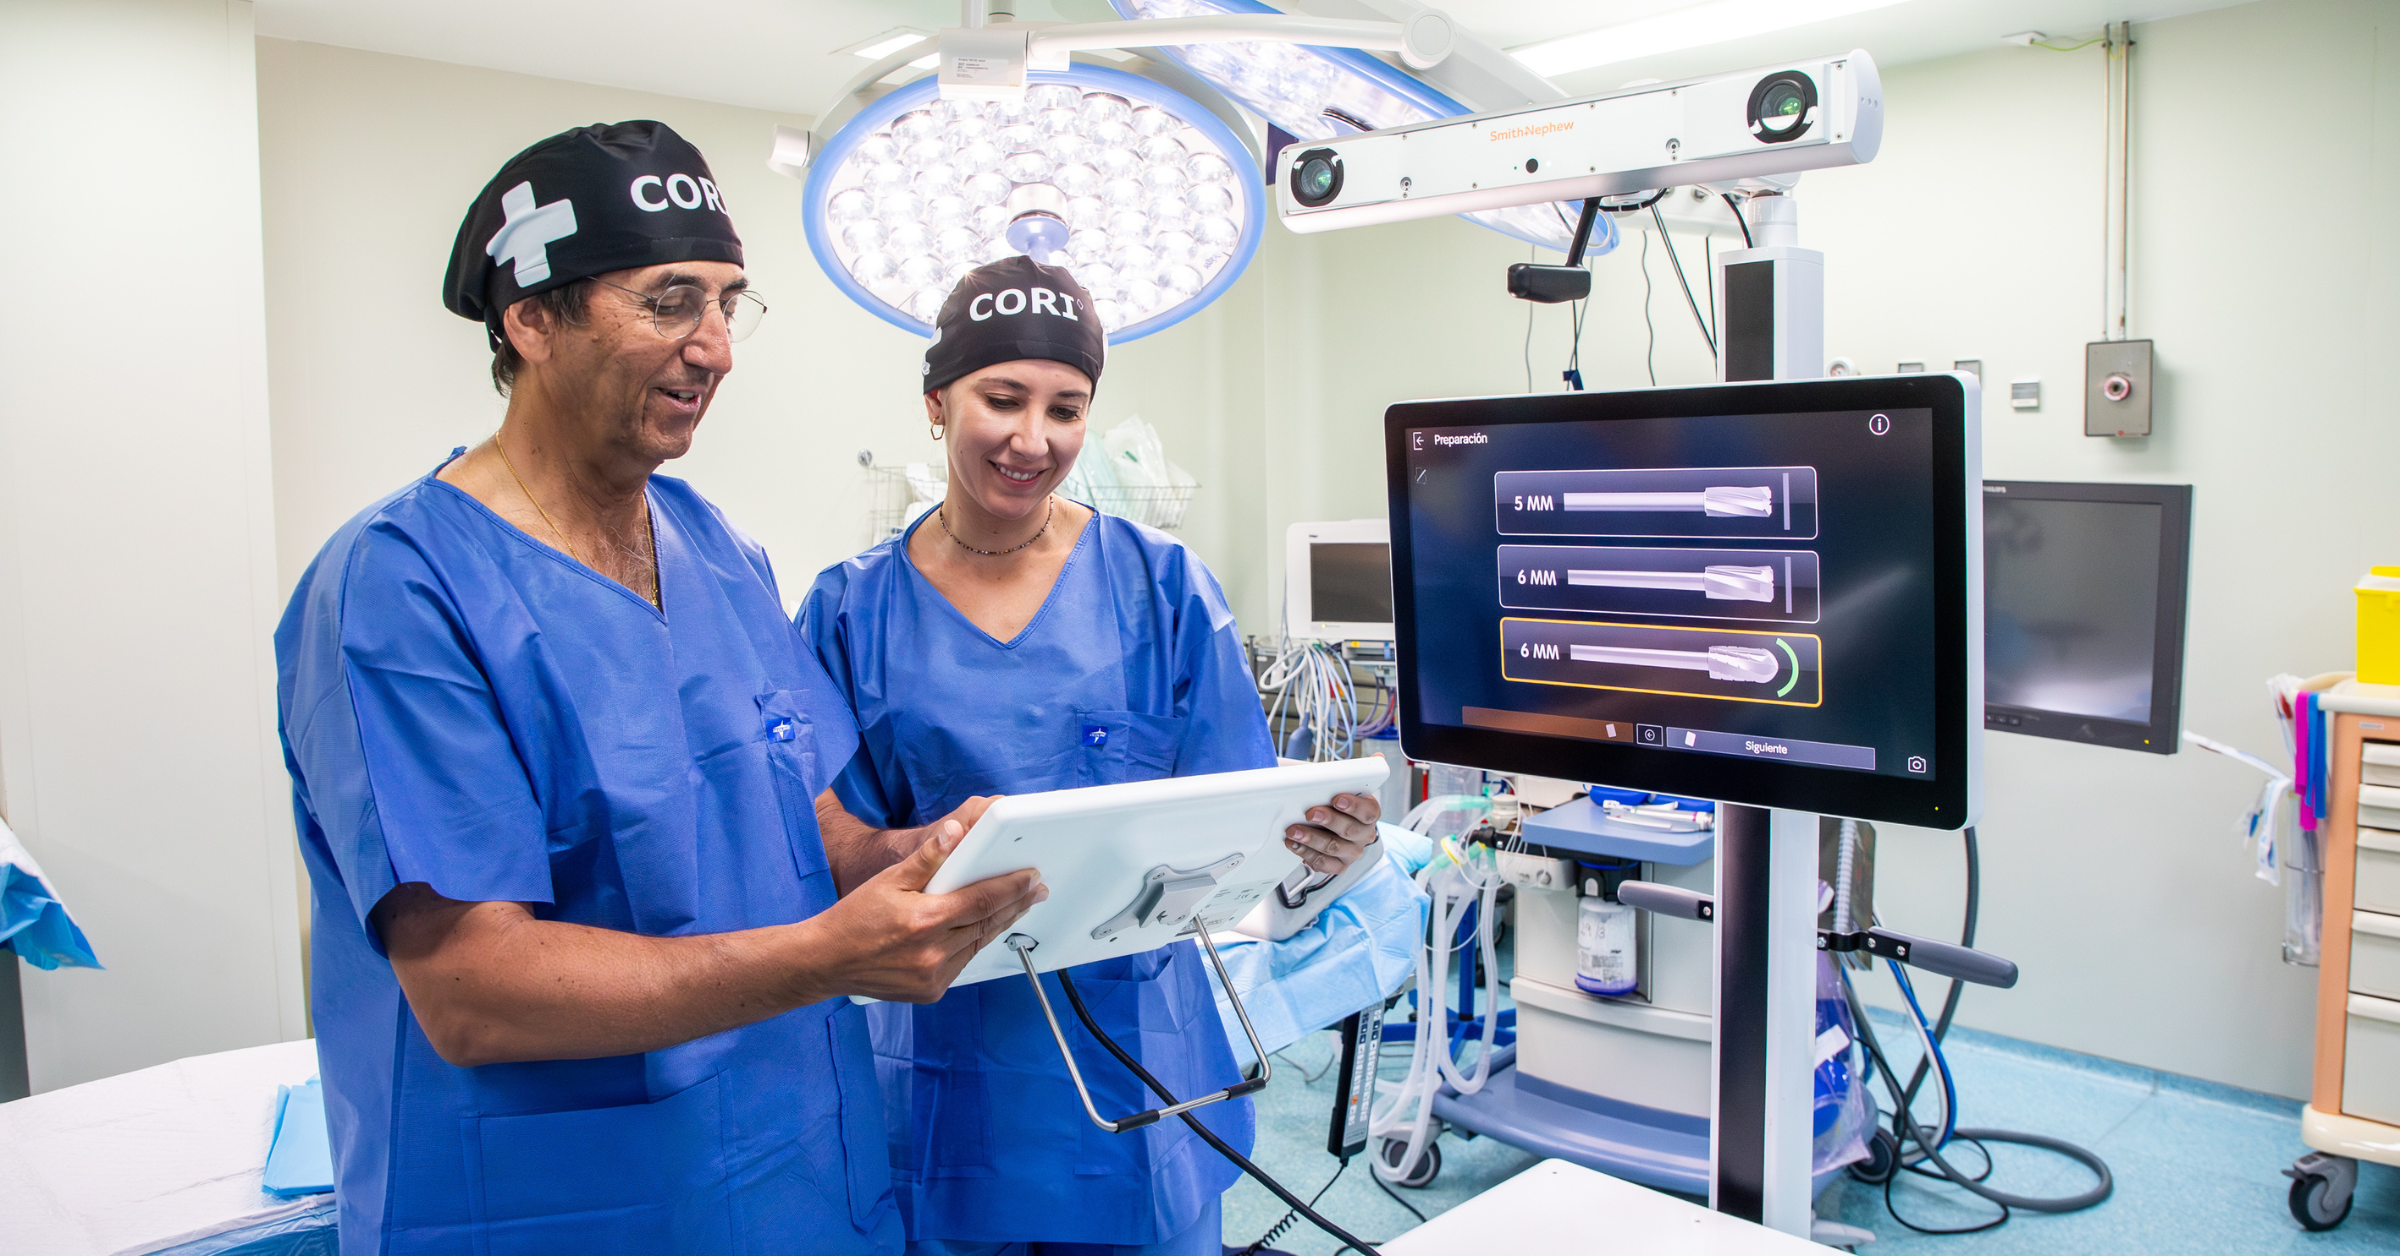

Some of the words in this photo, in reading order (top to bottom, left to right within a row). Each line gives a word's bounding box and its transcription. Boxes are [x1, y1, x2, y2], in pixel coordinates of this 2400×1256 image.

[1434, 432, 1488, 448] Preparación
[1514, 495, 1523, 511] 5
[1527, 495, 1554, 511] MM
[1517, 569, 1527, 585] 6
[1530, 569, 1557, 586] MM
[1520, 642, 1530, 658] 6
[1533, 643, 1560, 660] MM
[1745, 740, 1788, 755] Siguiente
